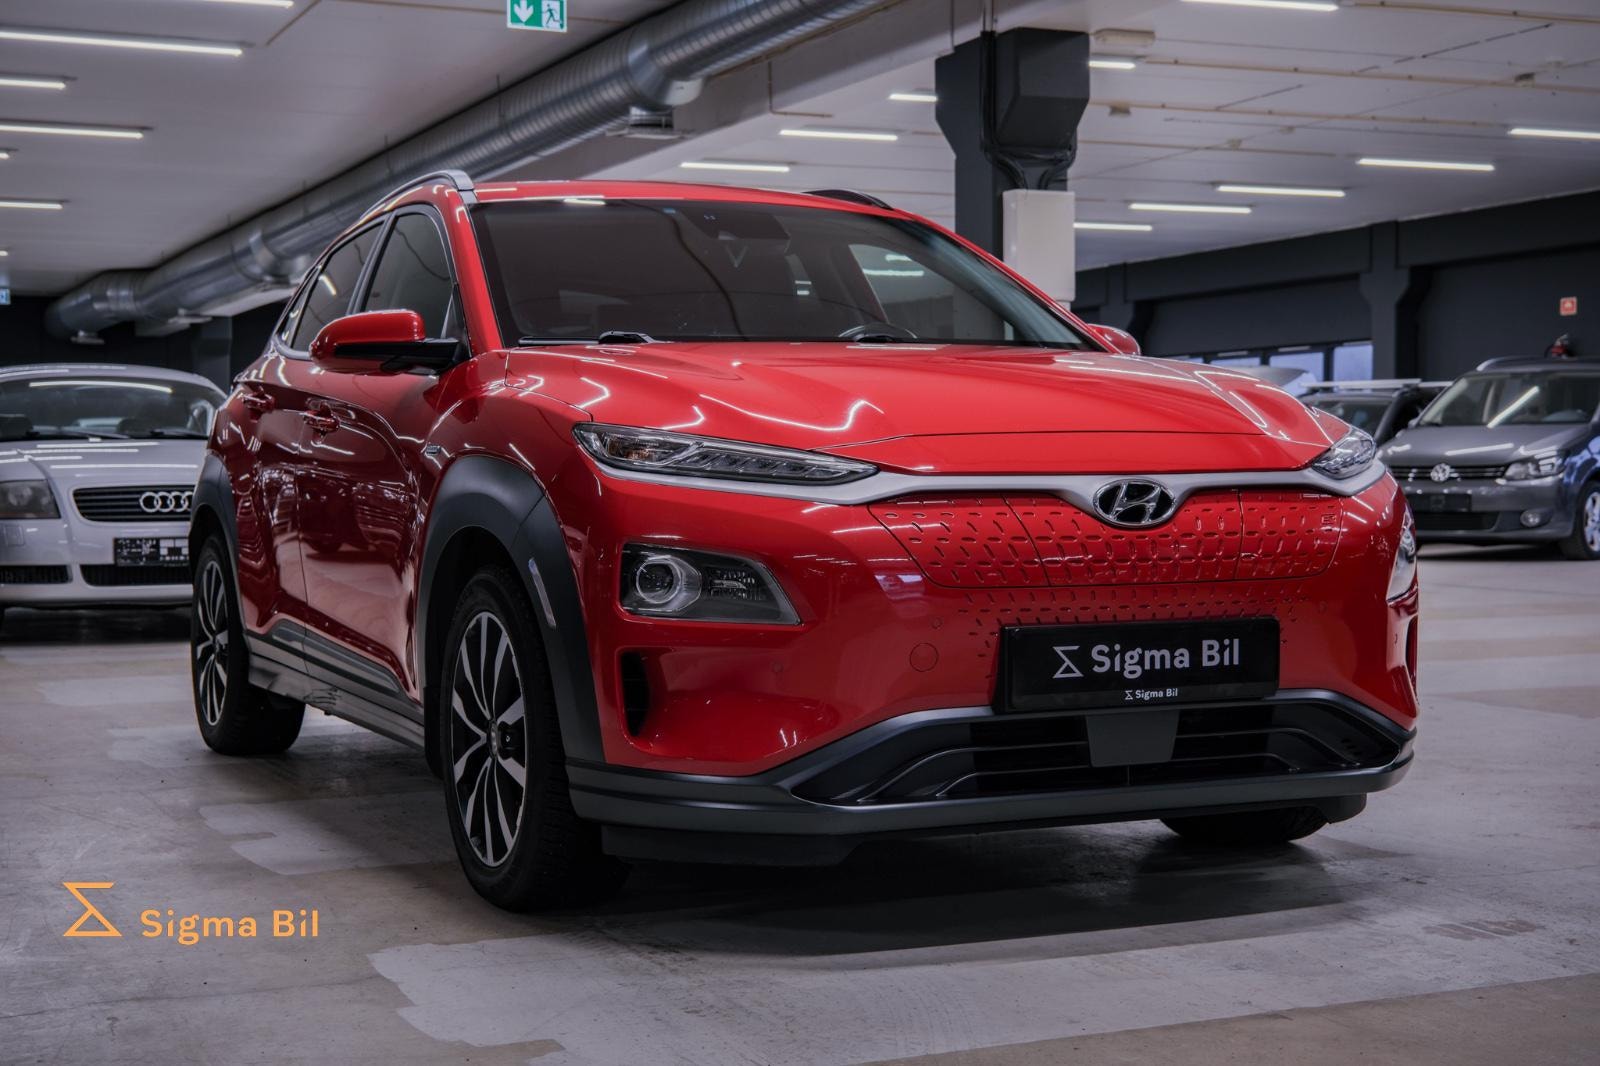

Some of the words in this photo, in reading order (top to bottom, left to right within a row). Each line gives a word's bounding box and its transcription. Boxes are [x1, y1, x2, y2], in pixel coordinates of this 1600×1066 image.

[1091, 643, 1190, 679] Sigma
[1202, 638, 1239, 667] Bil
[1135, 689, 1164, 700] Sigma
[1166, 688, 1178, 697] Bil
